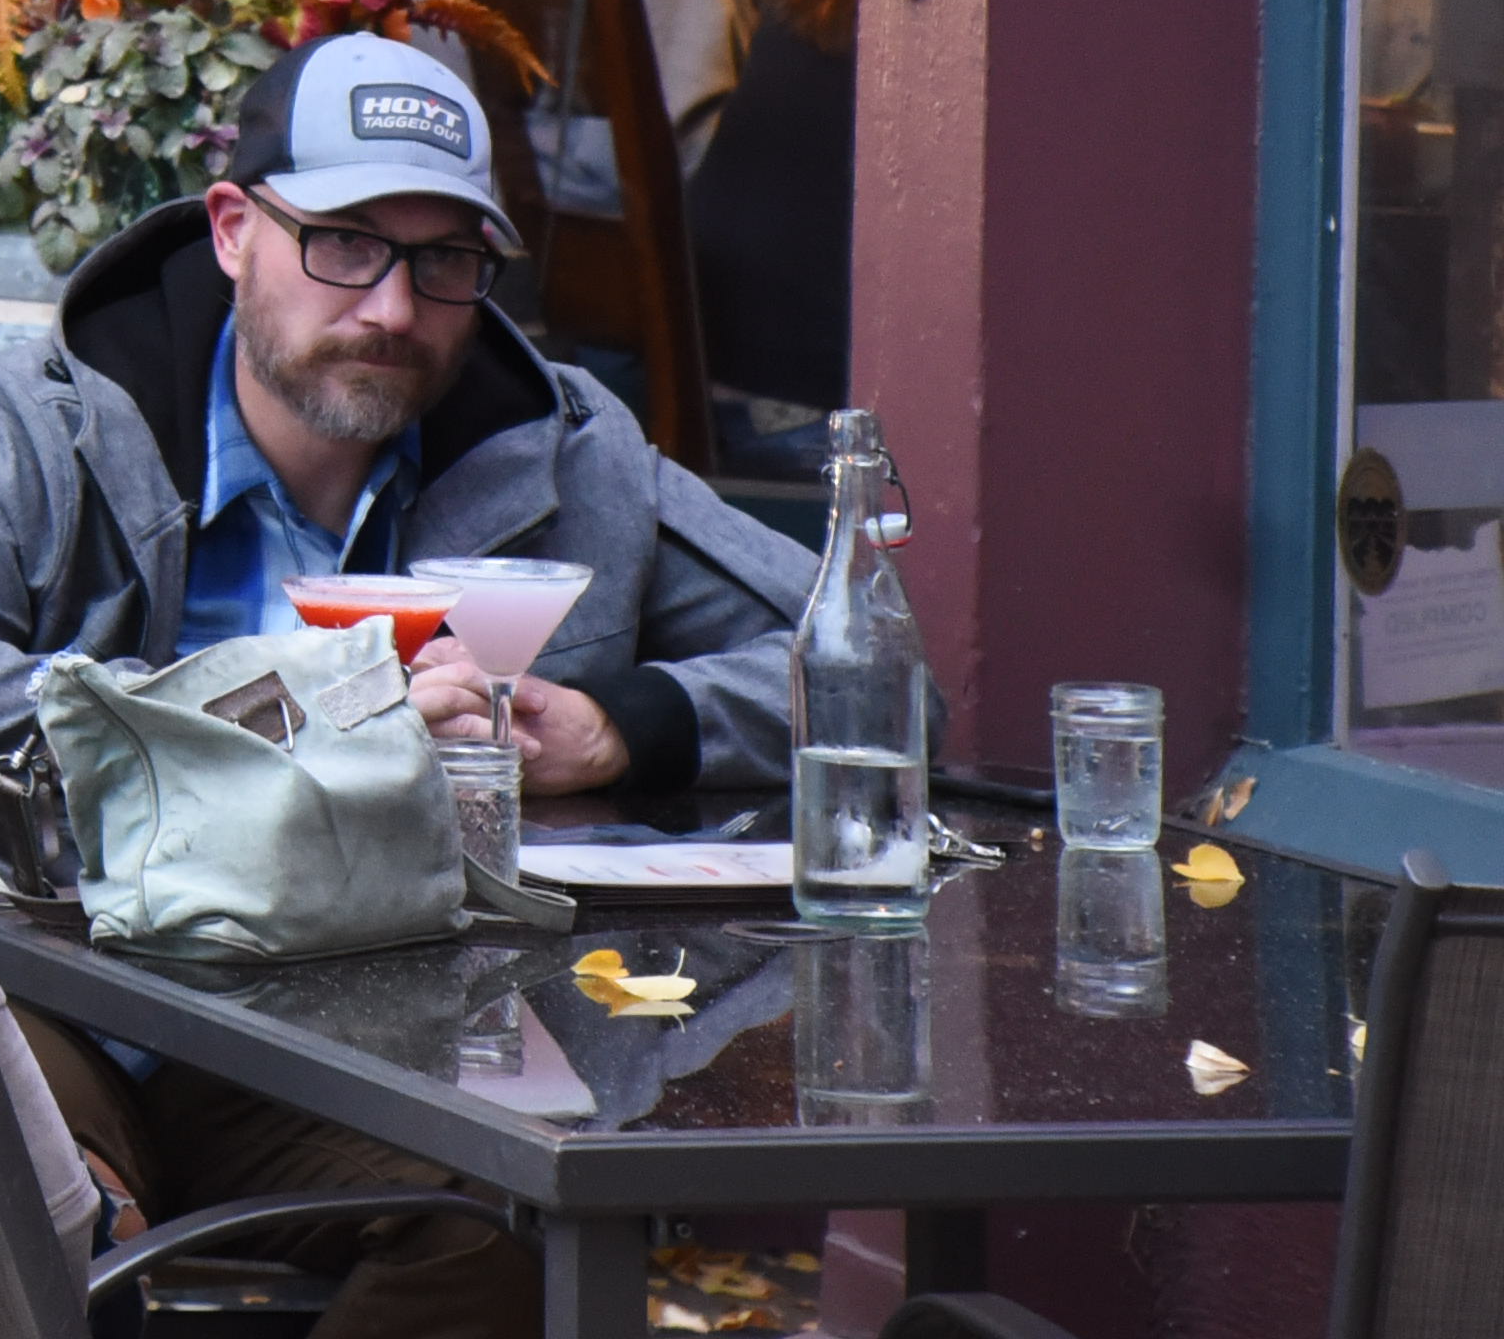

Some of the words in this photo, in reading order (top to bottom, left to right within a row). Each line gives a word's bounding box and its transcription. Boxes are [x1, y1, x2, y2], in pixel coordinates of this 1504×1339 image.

[362, 96, 462, 128] HOYT
[363, 115, 431, 131] TAGGED
[433, 124, 464, 145] OUT
